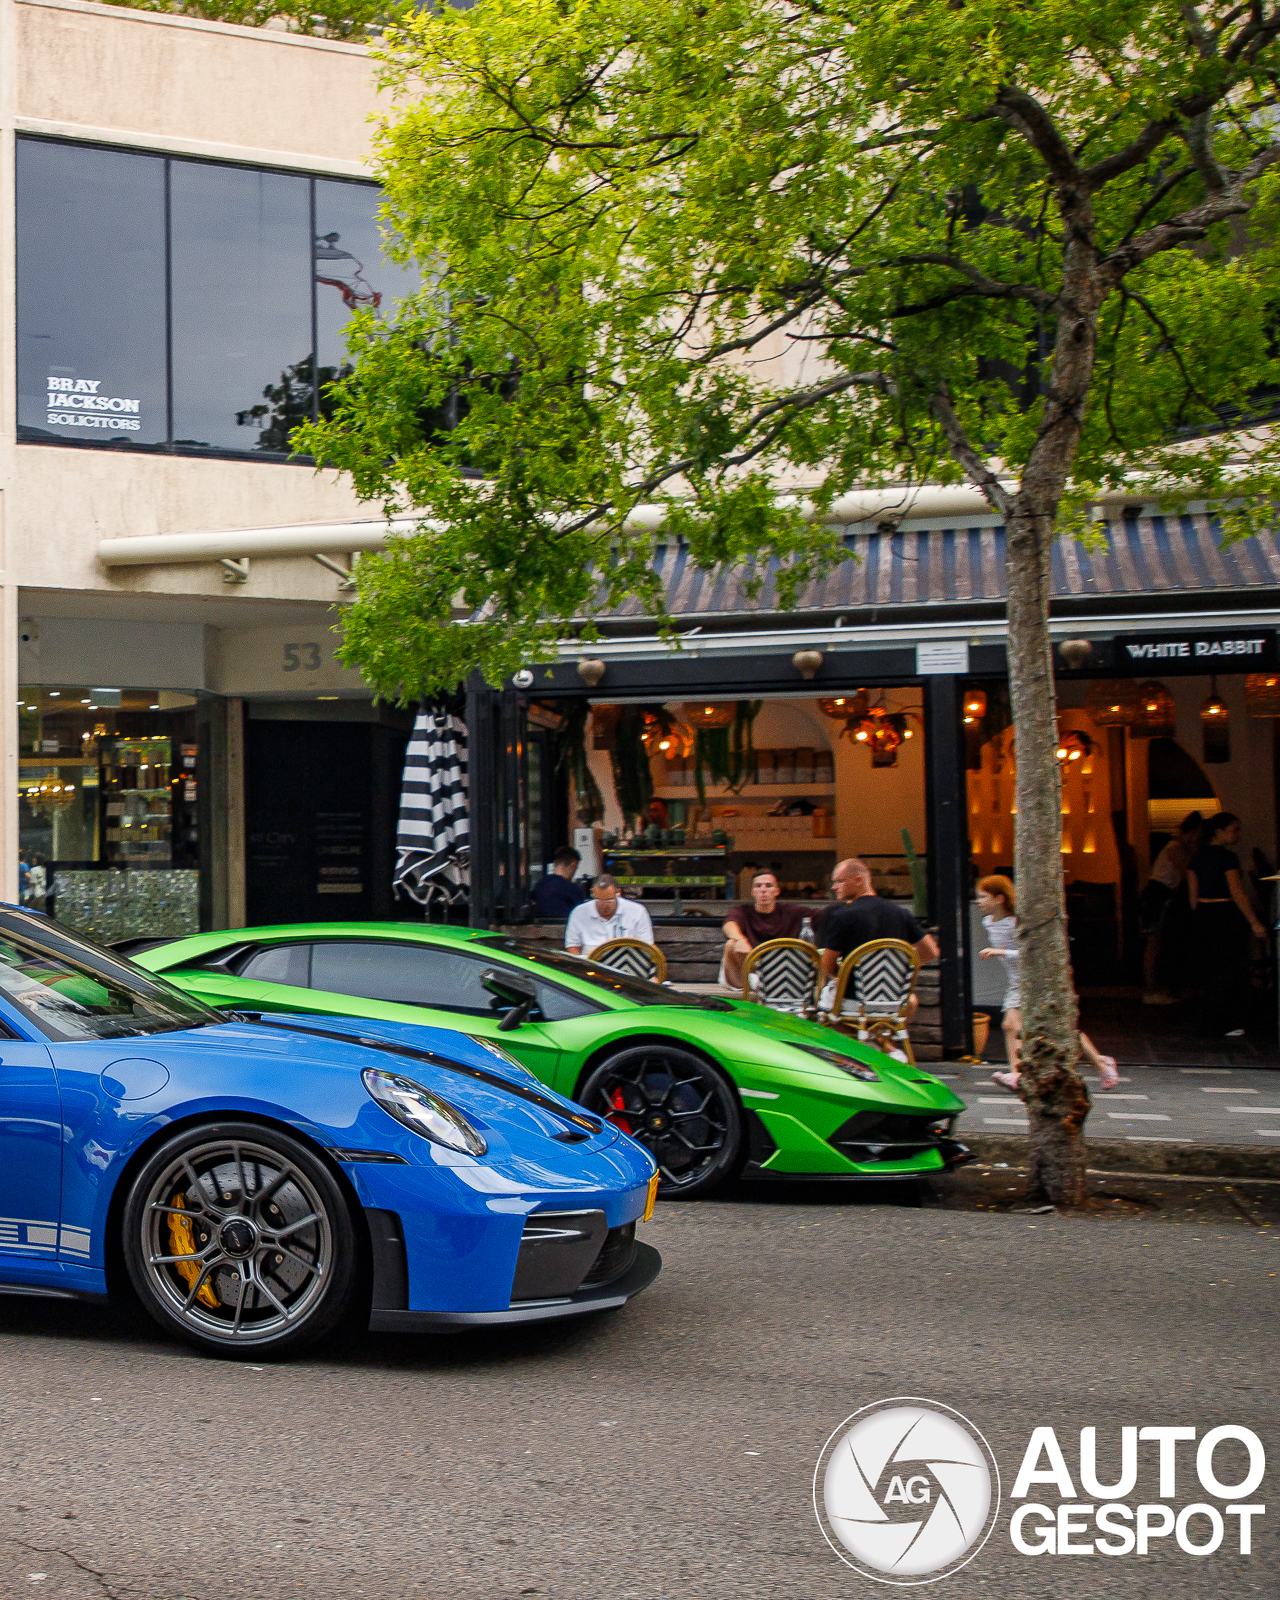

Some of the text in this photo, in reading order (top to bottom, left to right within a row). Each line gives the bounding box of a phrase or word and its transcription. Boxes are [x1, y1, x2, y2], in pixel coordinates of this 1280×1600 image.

[47, 377, 101, 393] BRAY
[47, 393, 140, 413] JACKSON
[47, 413, 141, 431] SOLICITORS
[282, 642, 321, 672] 53
[1125, 639, 1266, 658] WHITE RABBIT
